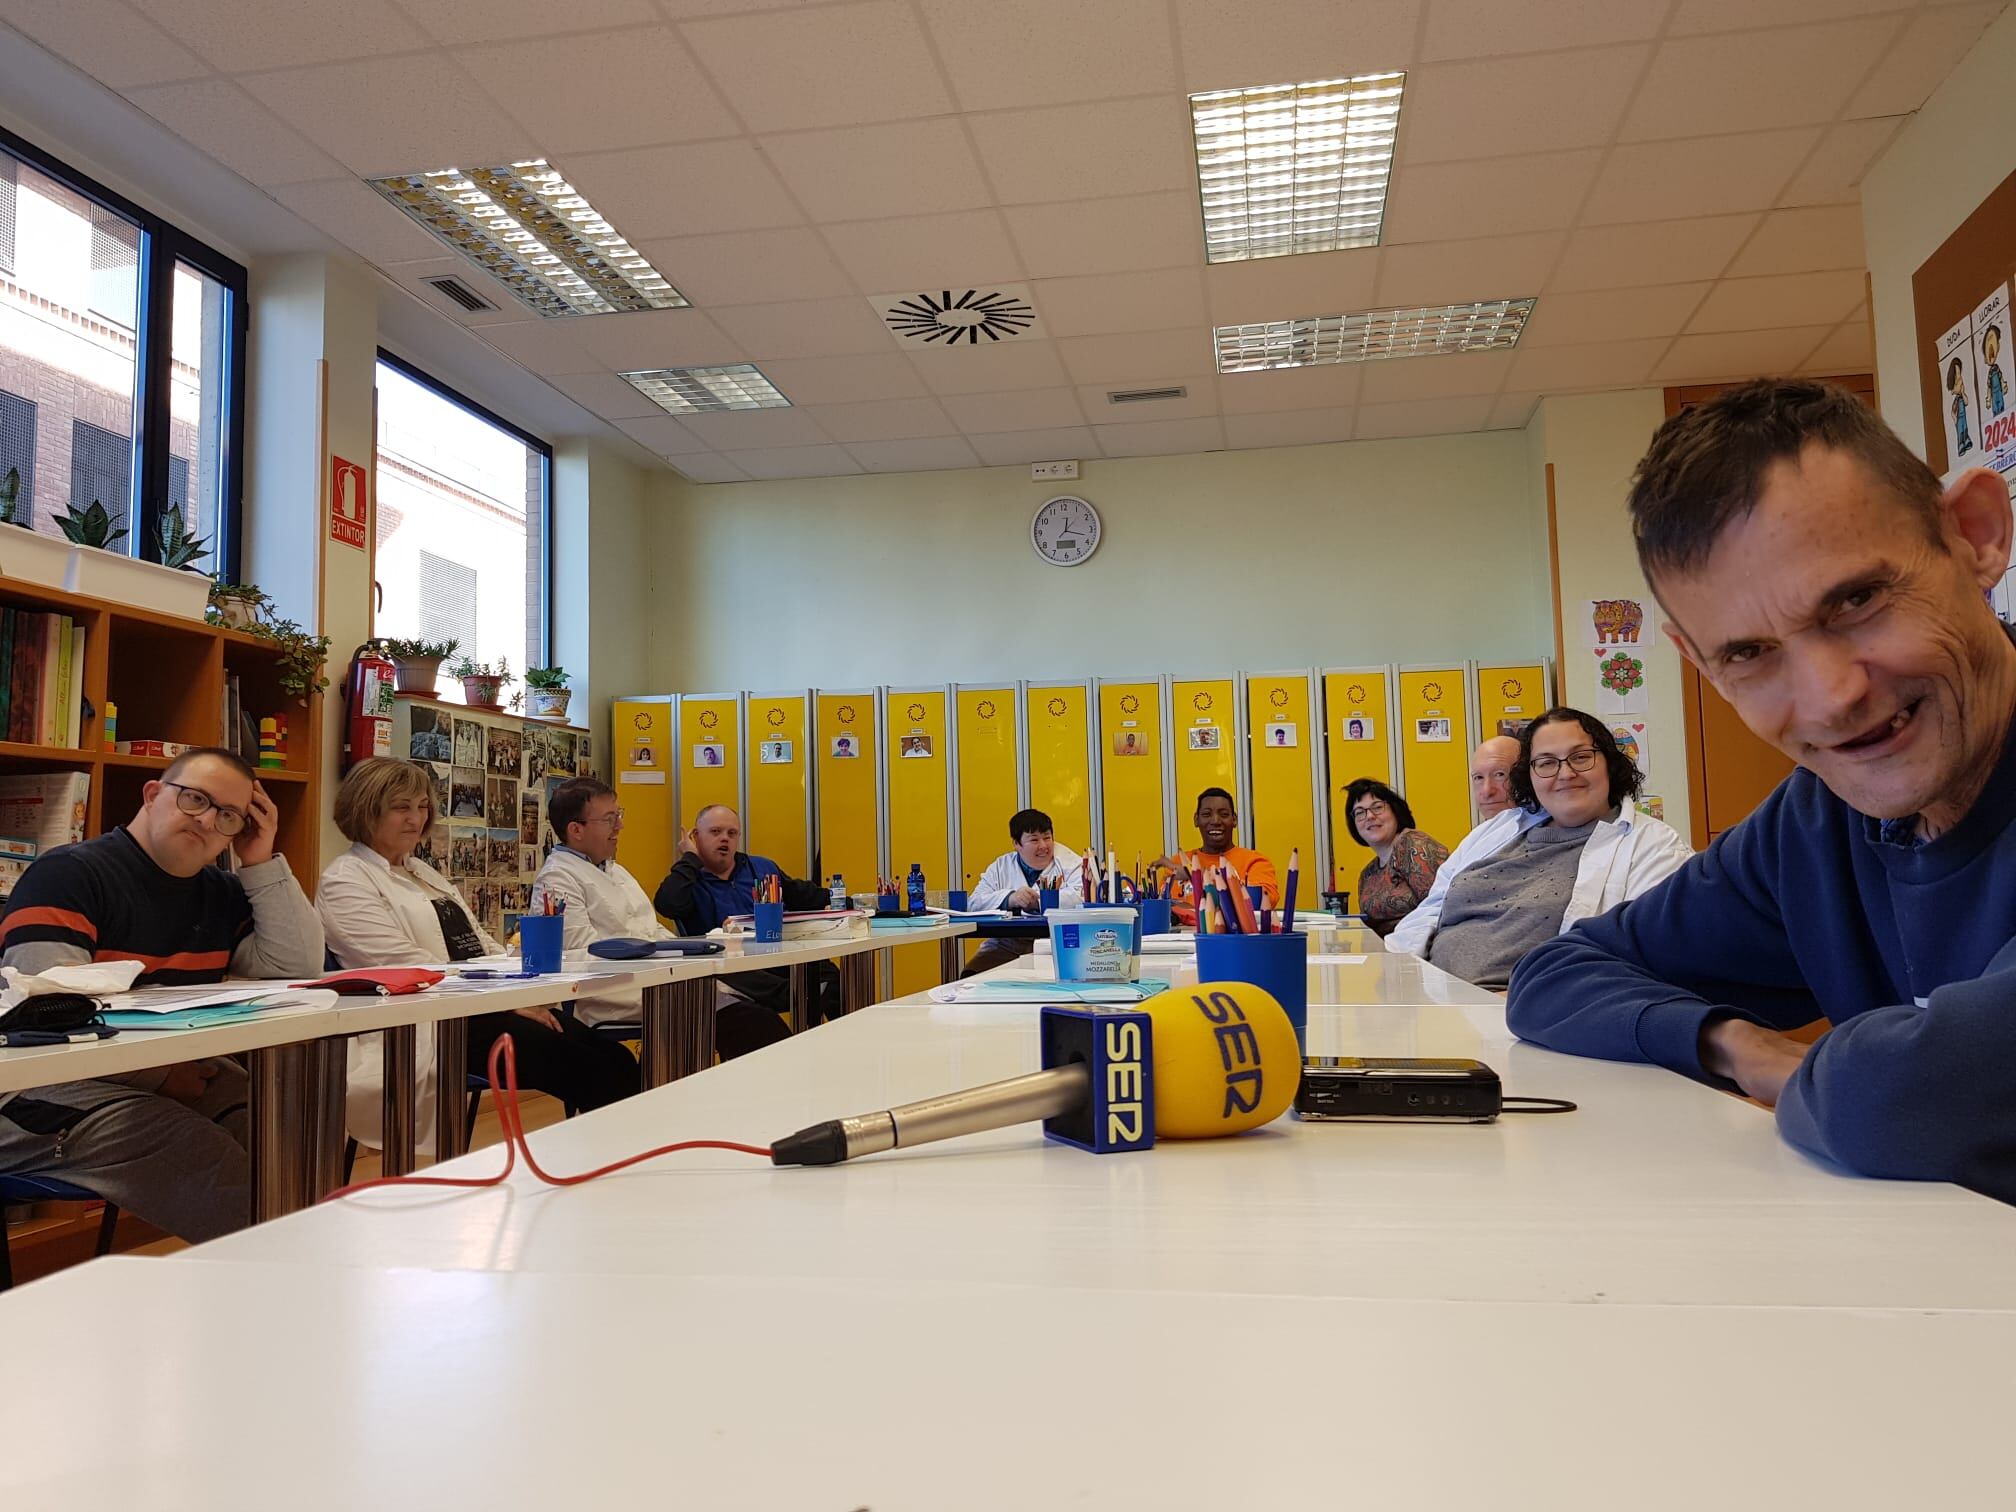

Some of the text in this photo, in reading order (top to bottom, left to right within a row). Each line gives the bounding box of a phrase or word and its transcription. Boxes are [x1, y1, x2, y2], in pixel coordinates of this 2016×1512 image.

[1978, 296, 2001, 323] LLORAR
[1984, 411, 2016, 454] 2024
[1060, 503, 1068, 511] 12
[1049, 508, 1056, 516] 11
[1084, 513, 1089, 521] 2
[1041, 518, 1049, 526] 10
[332, 519, 366, 545] EXTINTOR
[1042, 541, 1048, 549] 8
[1051, 549, 1057, 557] 7
[1064, 551, 1069, 559] 6
[1190, 991, 1264, 1119] SER
[1105, 1021, 1145, 1145] SER
